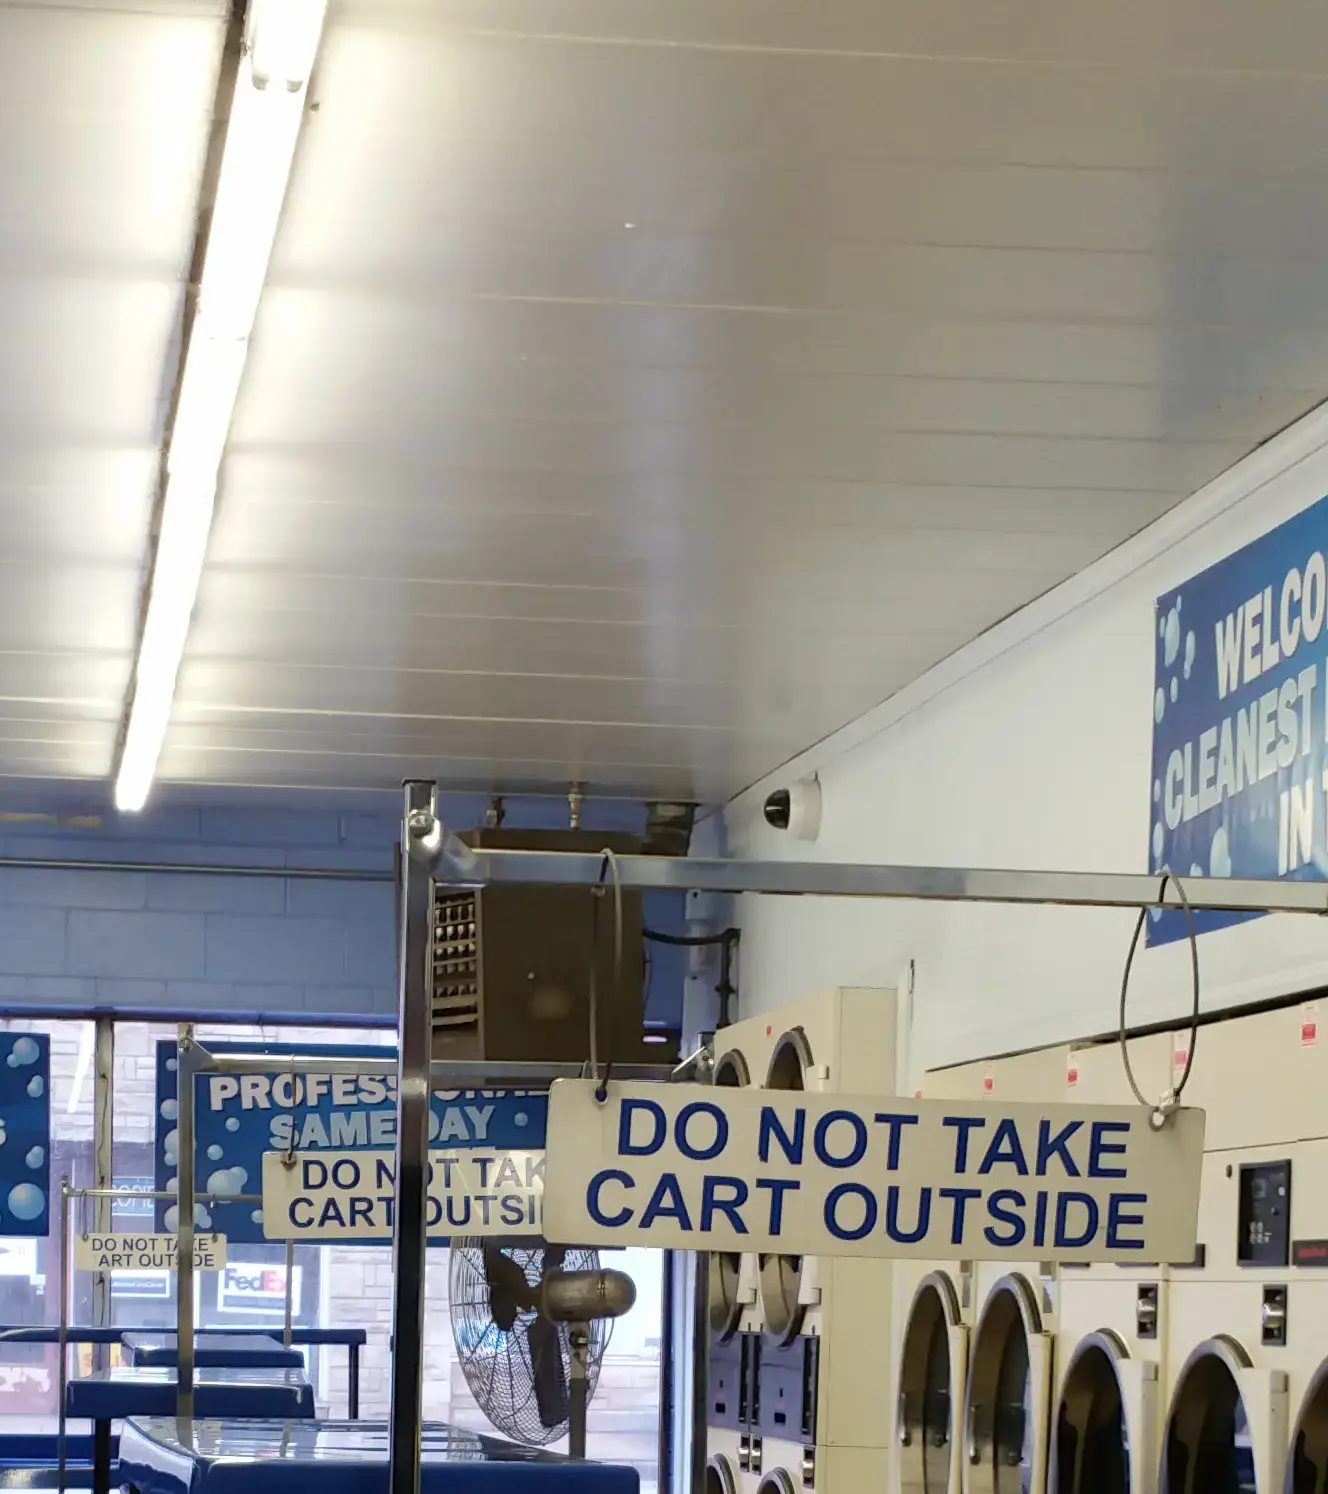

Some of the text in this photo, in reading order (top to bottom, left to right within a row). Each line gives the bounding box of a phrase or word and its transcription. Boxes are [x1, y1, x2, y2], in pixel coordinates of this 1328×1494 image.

[1164, 668, 1317, 831] CLEANEST
[1278, 777, 1313, 876] IN
[269, 1105, 495, 1149] SAME AY
[618, 1098, 1131, 1179] DO NOT TAKE
[302, 1157, 546, 1190] DO NT TAK
[289, 1195, 536, 1228] CART OUTSI
[586, 1169, 1149, 1250] CART OUTSIDE
[92, 1238, 208, 1251] DO NOT TE
[139, 1254, 214, 1267] OUTDE
